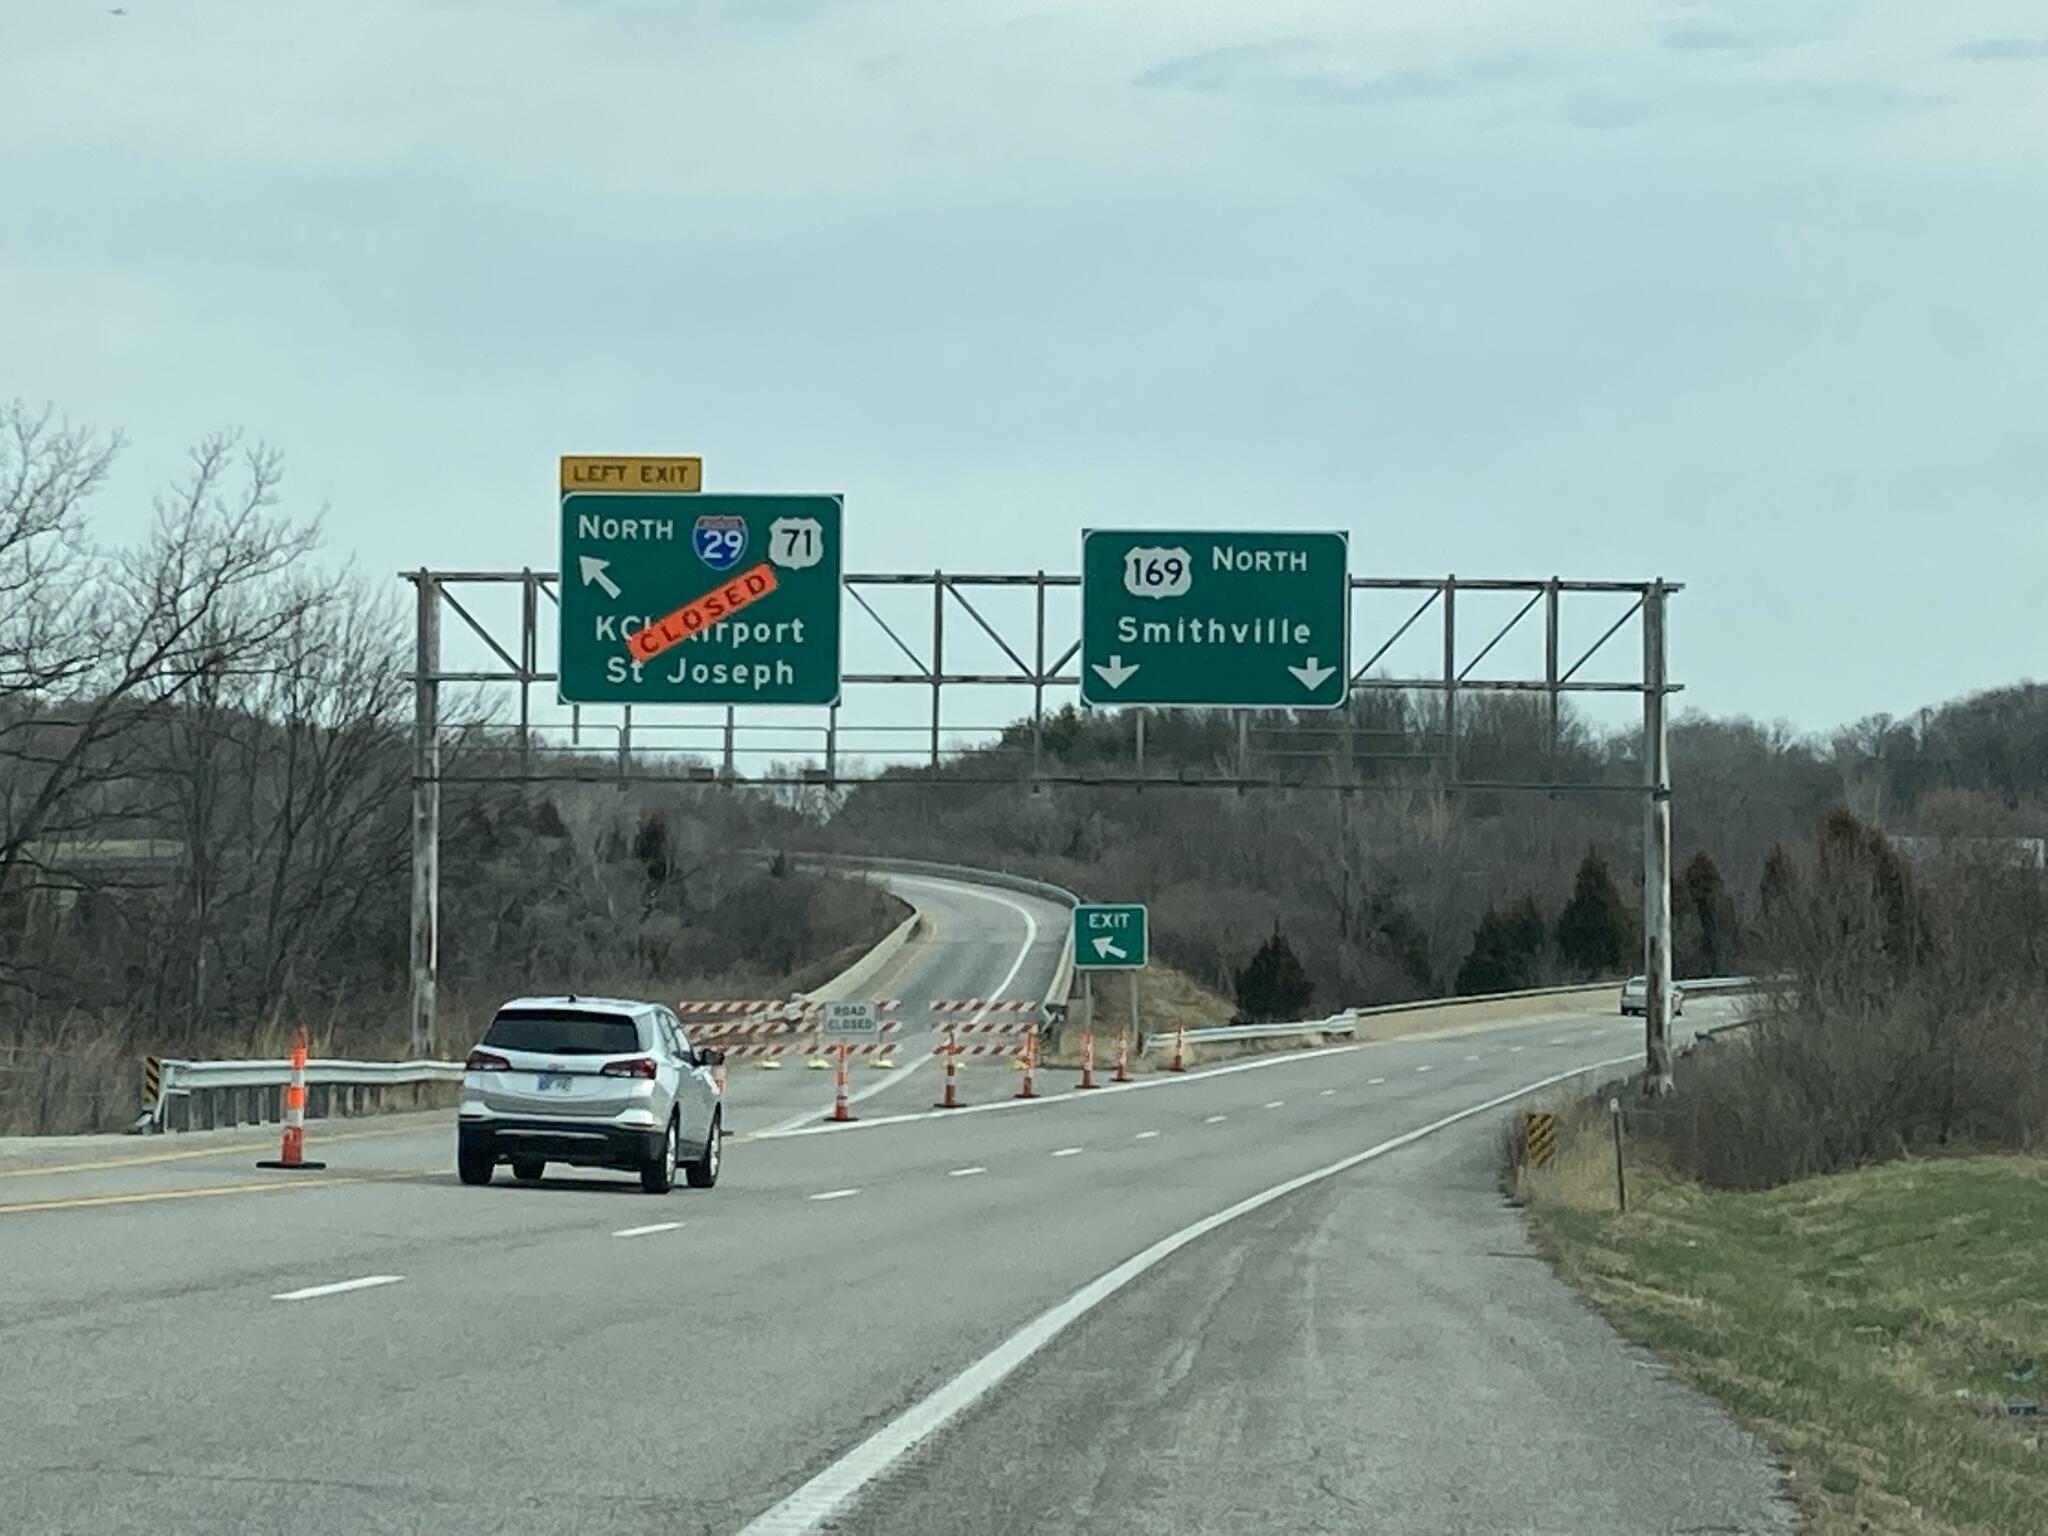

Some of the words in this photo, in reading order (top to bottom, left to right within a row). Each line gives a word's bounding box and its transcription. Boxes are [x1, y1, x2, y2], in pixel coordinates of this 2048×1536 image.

[573, 464, 627, 483] LEFT
[640, 465, 689, 484] EXIT
[578, 514, 674, 541] NORTH
[703, 530, 744, 559] 29
[780, 529, 812, 557] 71
[1133, 557, 1183, 587] 169
[1212, 545, 1308, 572] NORTH
[639, 573, 767, 654] CLOSED
[1118, 615, 1311, 645] Smithville
[605, 656, 645, 684] St
[666, 657, 794, 690] Joseph
[1088, 912, 1131, 929] EXIT
[828, 1018, 874, 1030] CLOSED
[833, 1005, 867, 1016] ROAD
